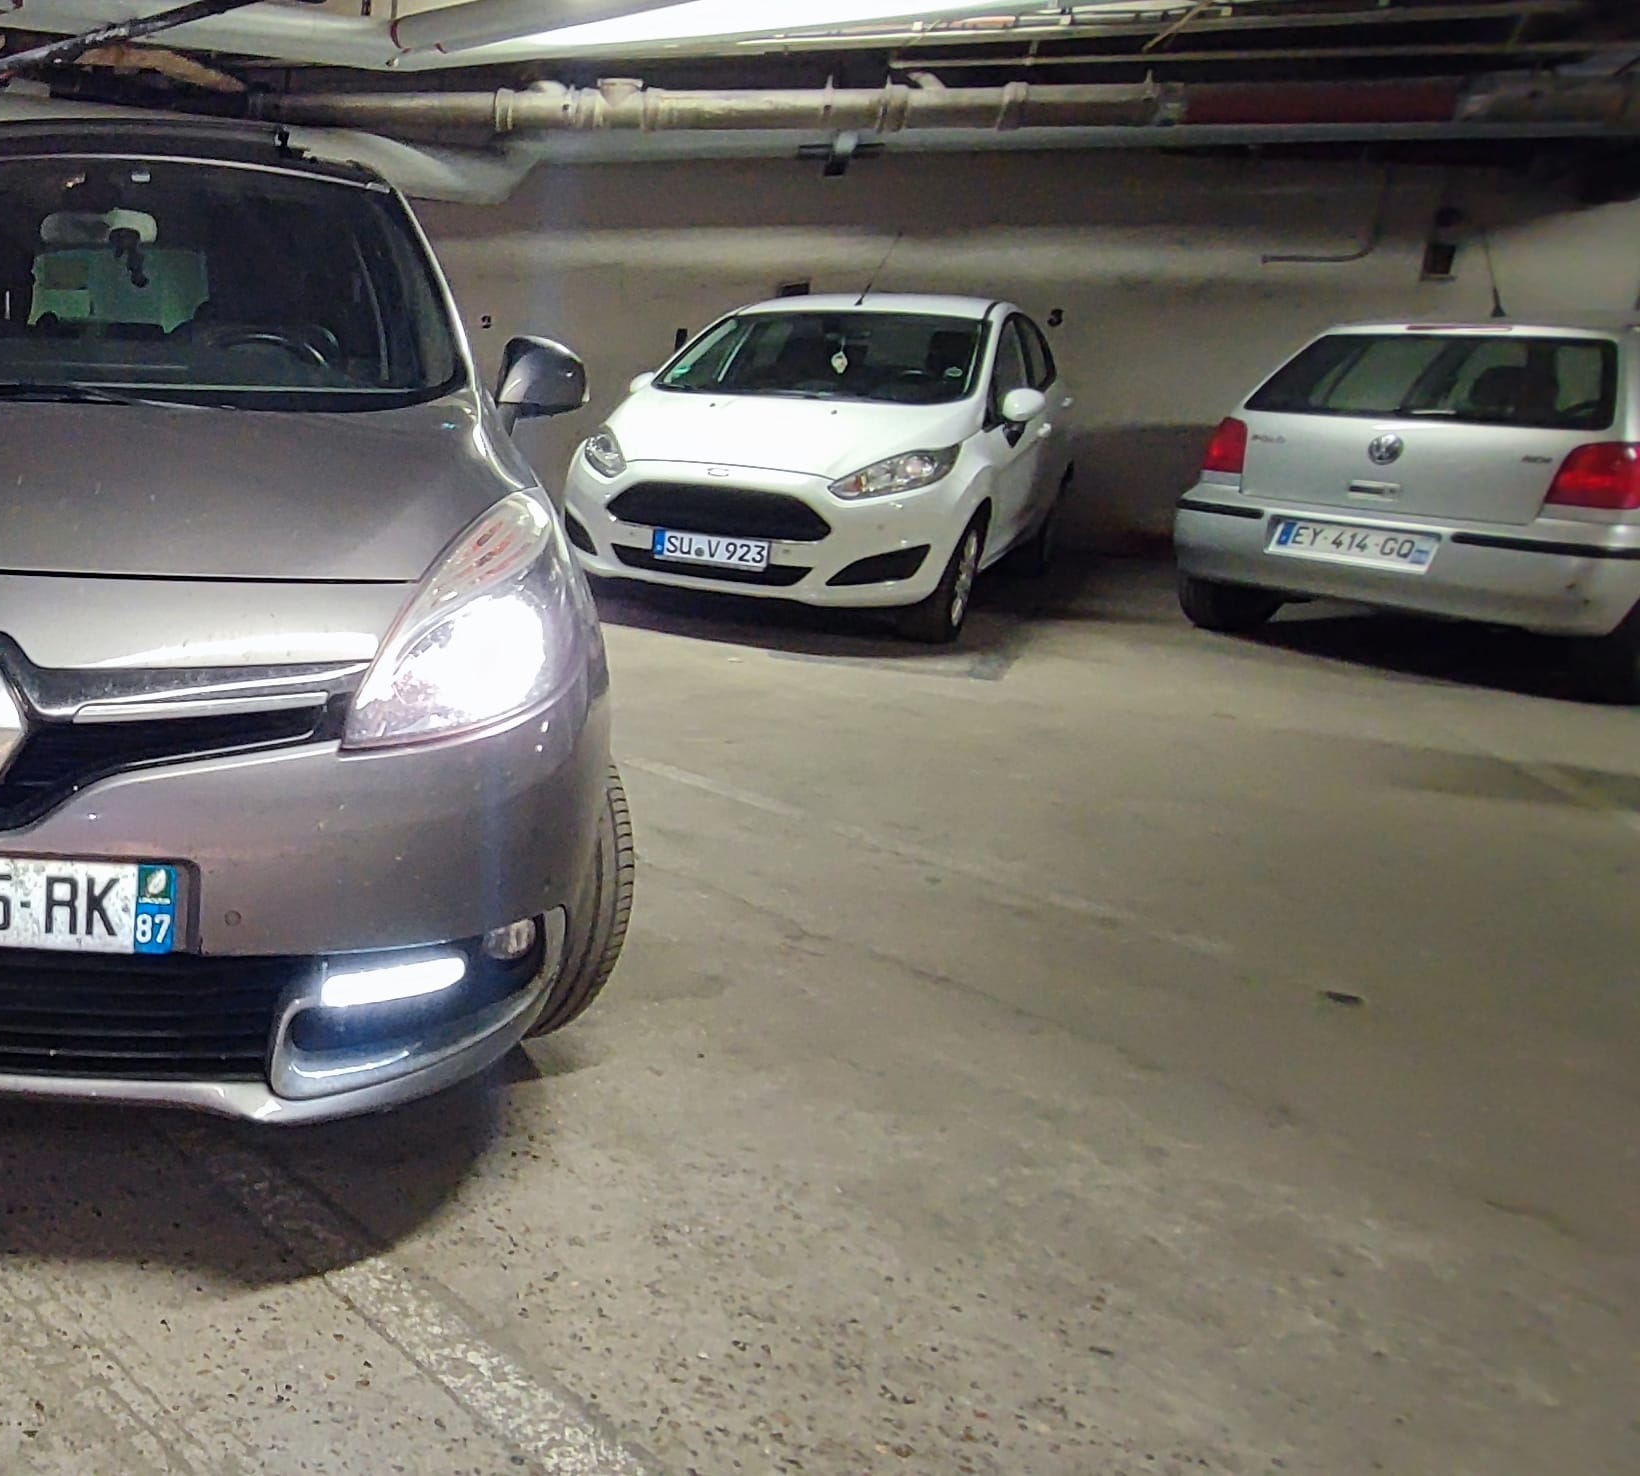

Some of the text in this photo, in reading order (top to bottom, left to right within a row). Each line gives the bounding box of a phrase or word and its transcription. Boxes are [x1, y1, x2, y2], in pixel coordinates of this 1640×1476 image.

[666, 535, 693, 555] SU
[725, 542, 766, 564] 923
[136, 913, 171, 944] 87
